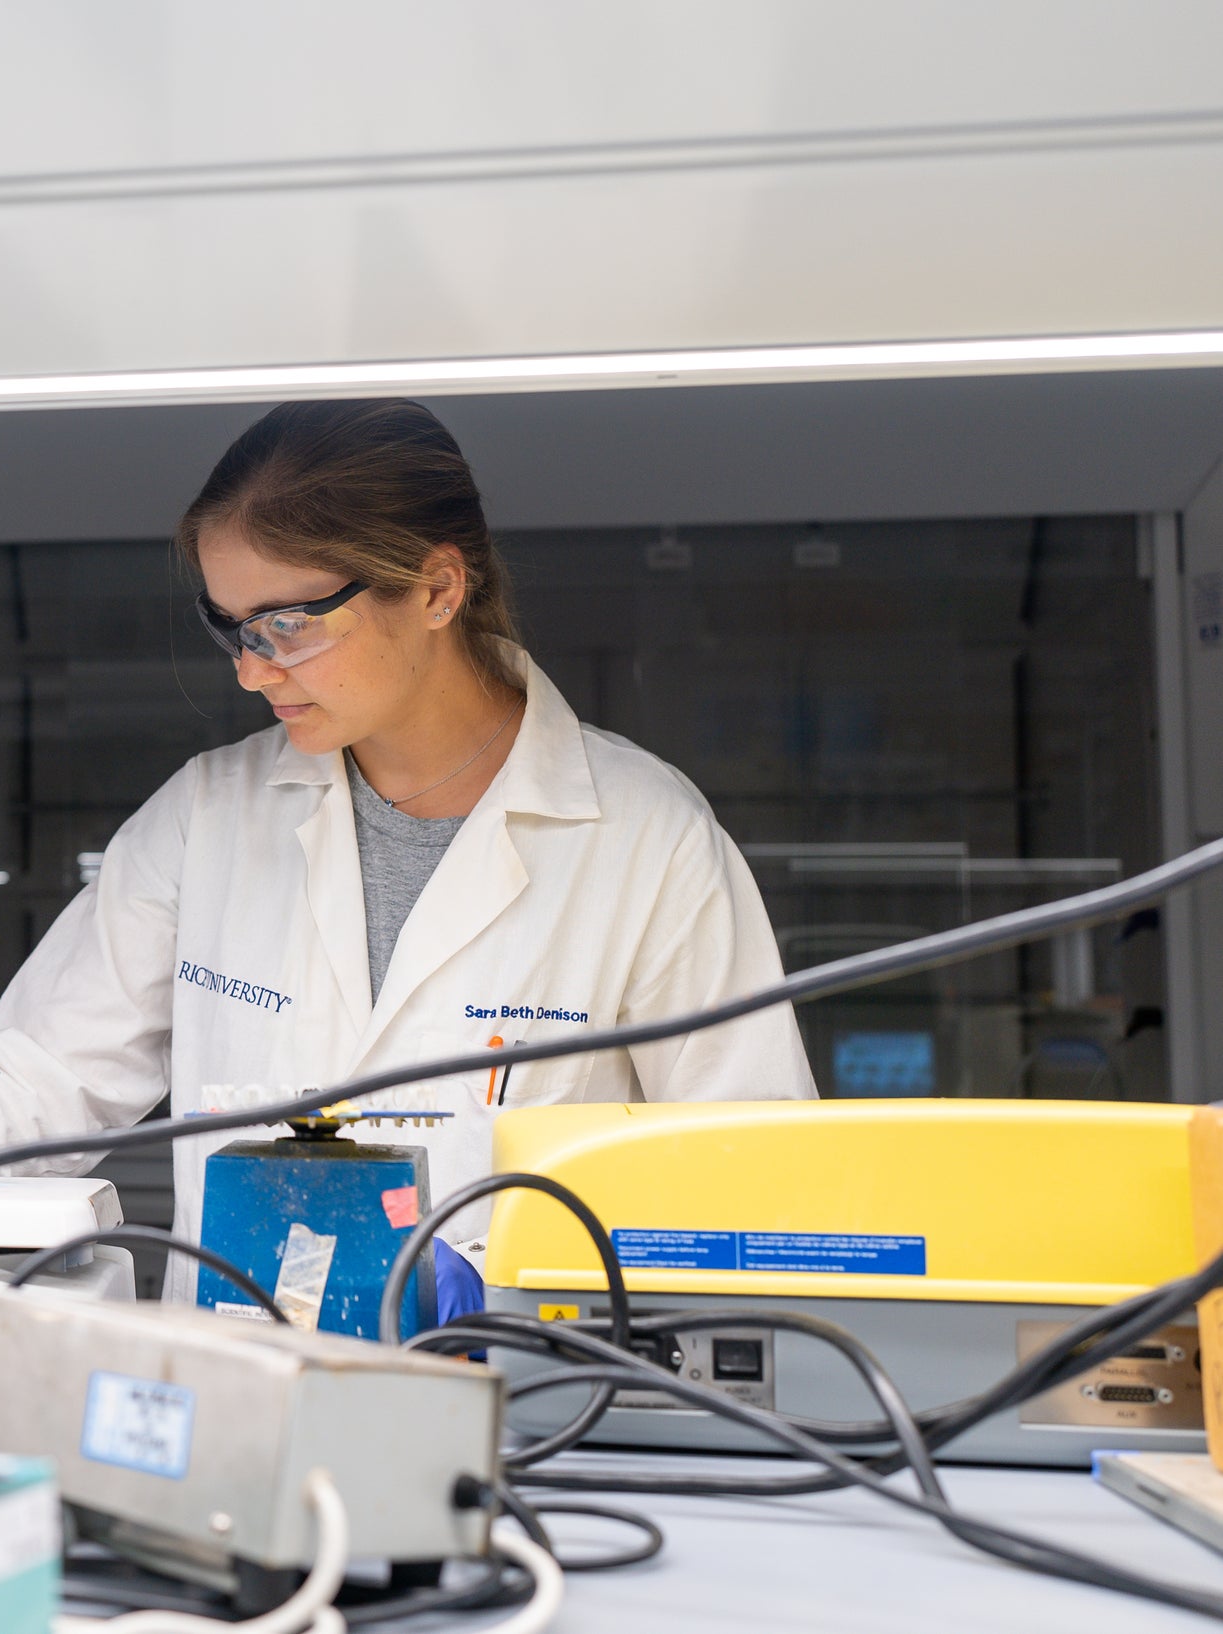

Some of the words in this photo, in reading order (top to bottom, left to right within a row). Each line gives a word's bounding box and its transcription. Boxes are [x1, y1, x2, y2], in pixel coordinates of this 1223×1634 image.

[178, 960, 205, 987] RIC
[465, 1004, 496, 1019] Sara
[501, 1005, 534, 1020] Beth
[536, 1006, 588, 1023] Denison
